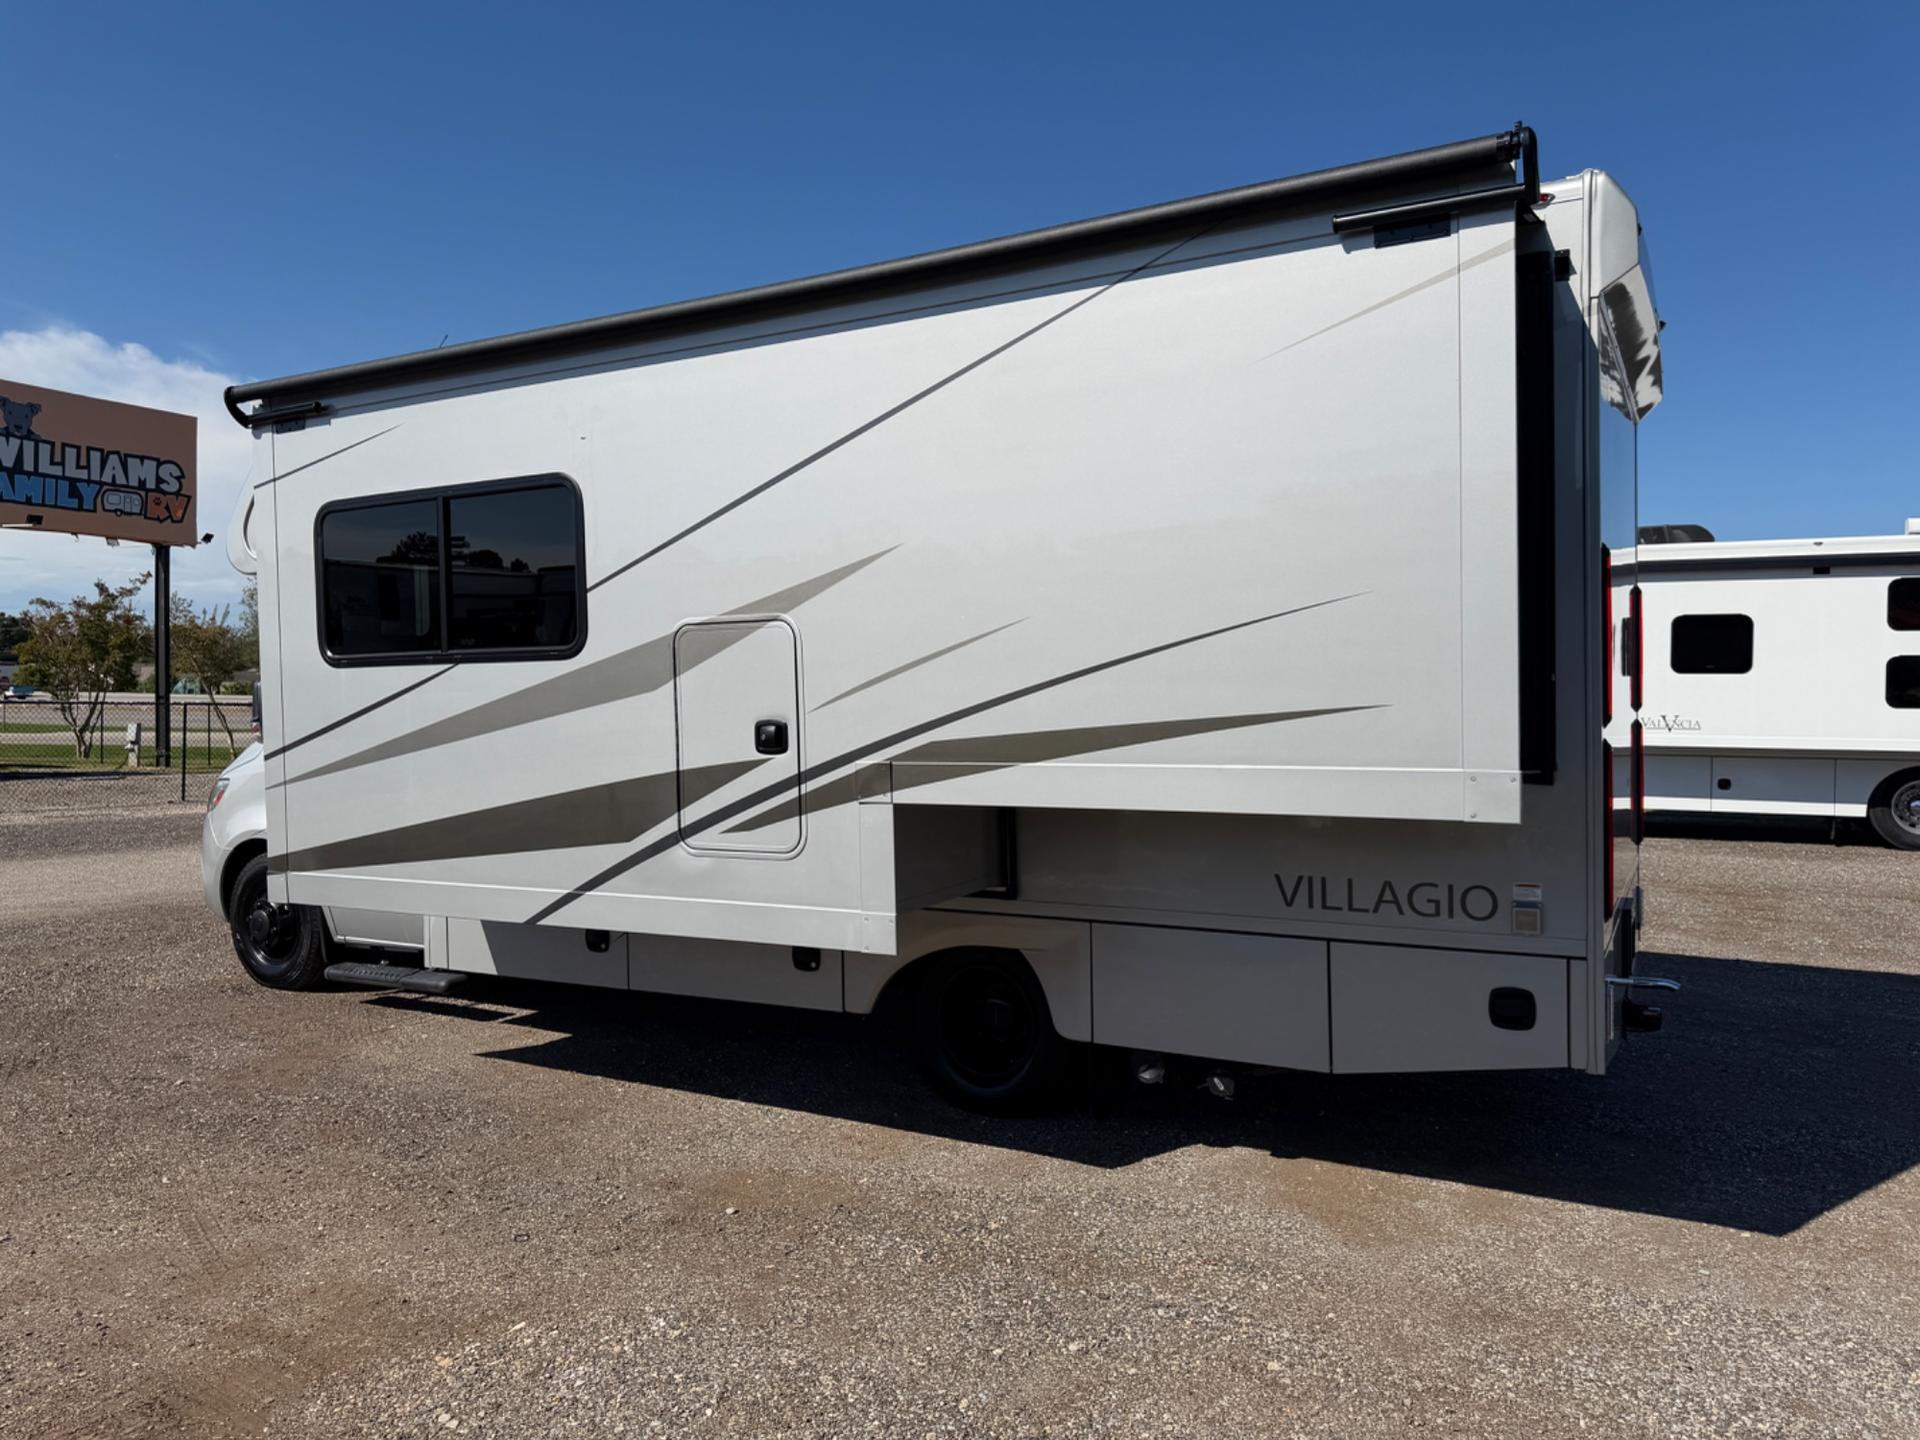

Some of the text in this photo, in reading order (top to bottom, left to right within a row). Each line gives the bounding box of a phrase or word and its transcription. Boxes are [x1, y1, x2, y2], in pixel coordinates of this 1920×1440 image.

[0, 471, 191, 523] AMILY RV
[1274, 873, 1498, 921] VILLAGIO
